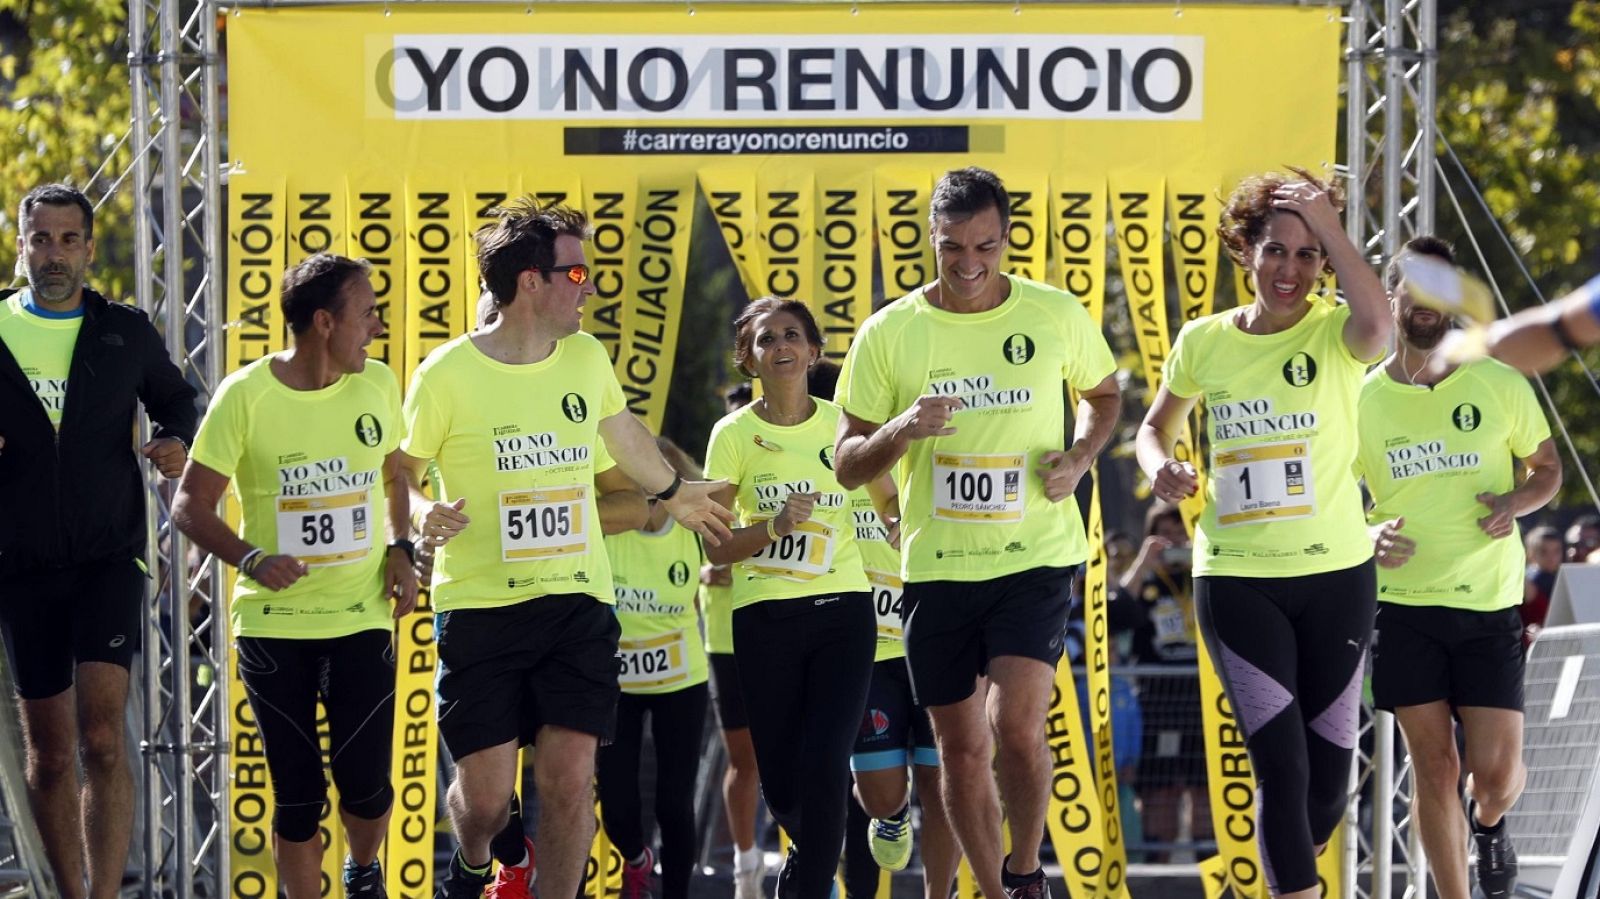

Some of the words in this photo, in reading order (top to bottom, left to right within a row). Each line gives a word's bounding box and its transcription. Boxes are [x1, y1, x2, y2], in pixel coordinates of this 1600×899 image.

[404, 46, 529, 112] YO
[564, 47, 688, 112] NO
[723, 46, 1193, 113] RENUNCIO
[623, 129, 909, 154] #carrerayonorenuncio
[931, 380, 957, 395] YO
[963, 375, 989, 392] NO
[958, 388, 1031, 410] NUNCIO
[1239, 399, 1268, 417] NO
[1216, 413, 1315, 440] RENUNCIO
[495, 437, 521, 454] YO
[528, 433, 553, 449] NO
[1387, 447, 1412, 464] YO
[1417, 441, 1442, 456] NO
[280, 466, 308, 483] YO
[315, 458, 344, 474] NO
[497, 446, 588, 471] RENUNCIO
[1391, 452, 1479, 480] RENUNCIO
[755, 485, 778, 500] YO
[946, 471, 993, 502] 100
[1239, 466, 1252, 500] 1
[302, 513, 335, 545] 58
[508, 505, 570, 540] 5105
[853, 511, 876, 524] YO
[857, 526, 888, 540] REN
[401, 688, 431, 844] CORRO
